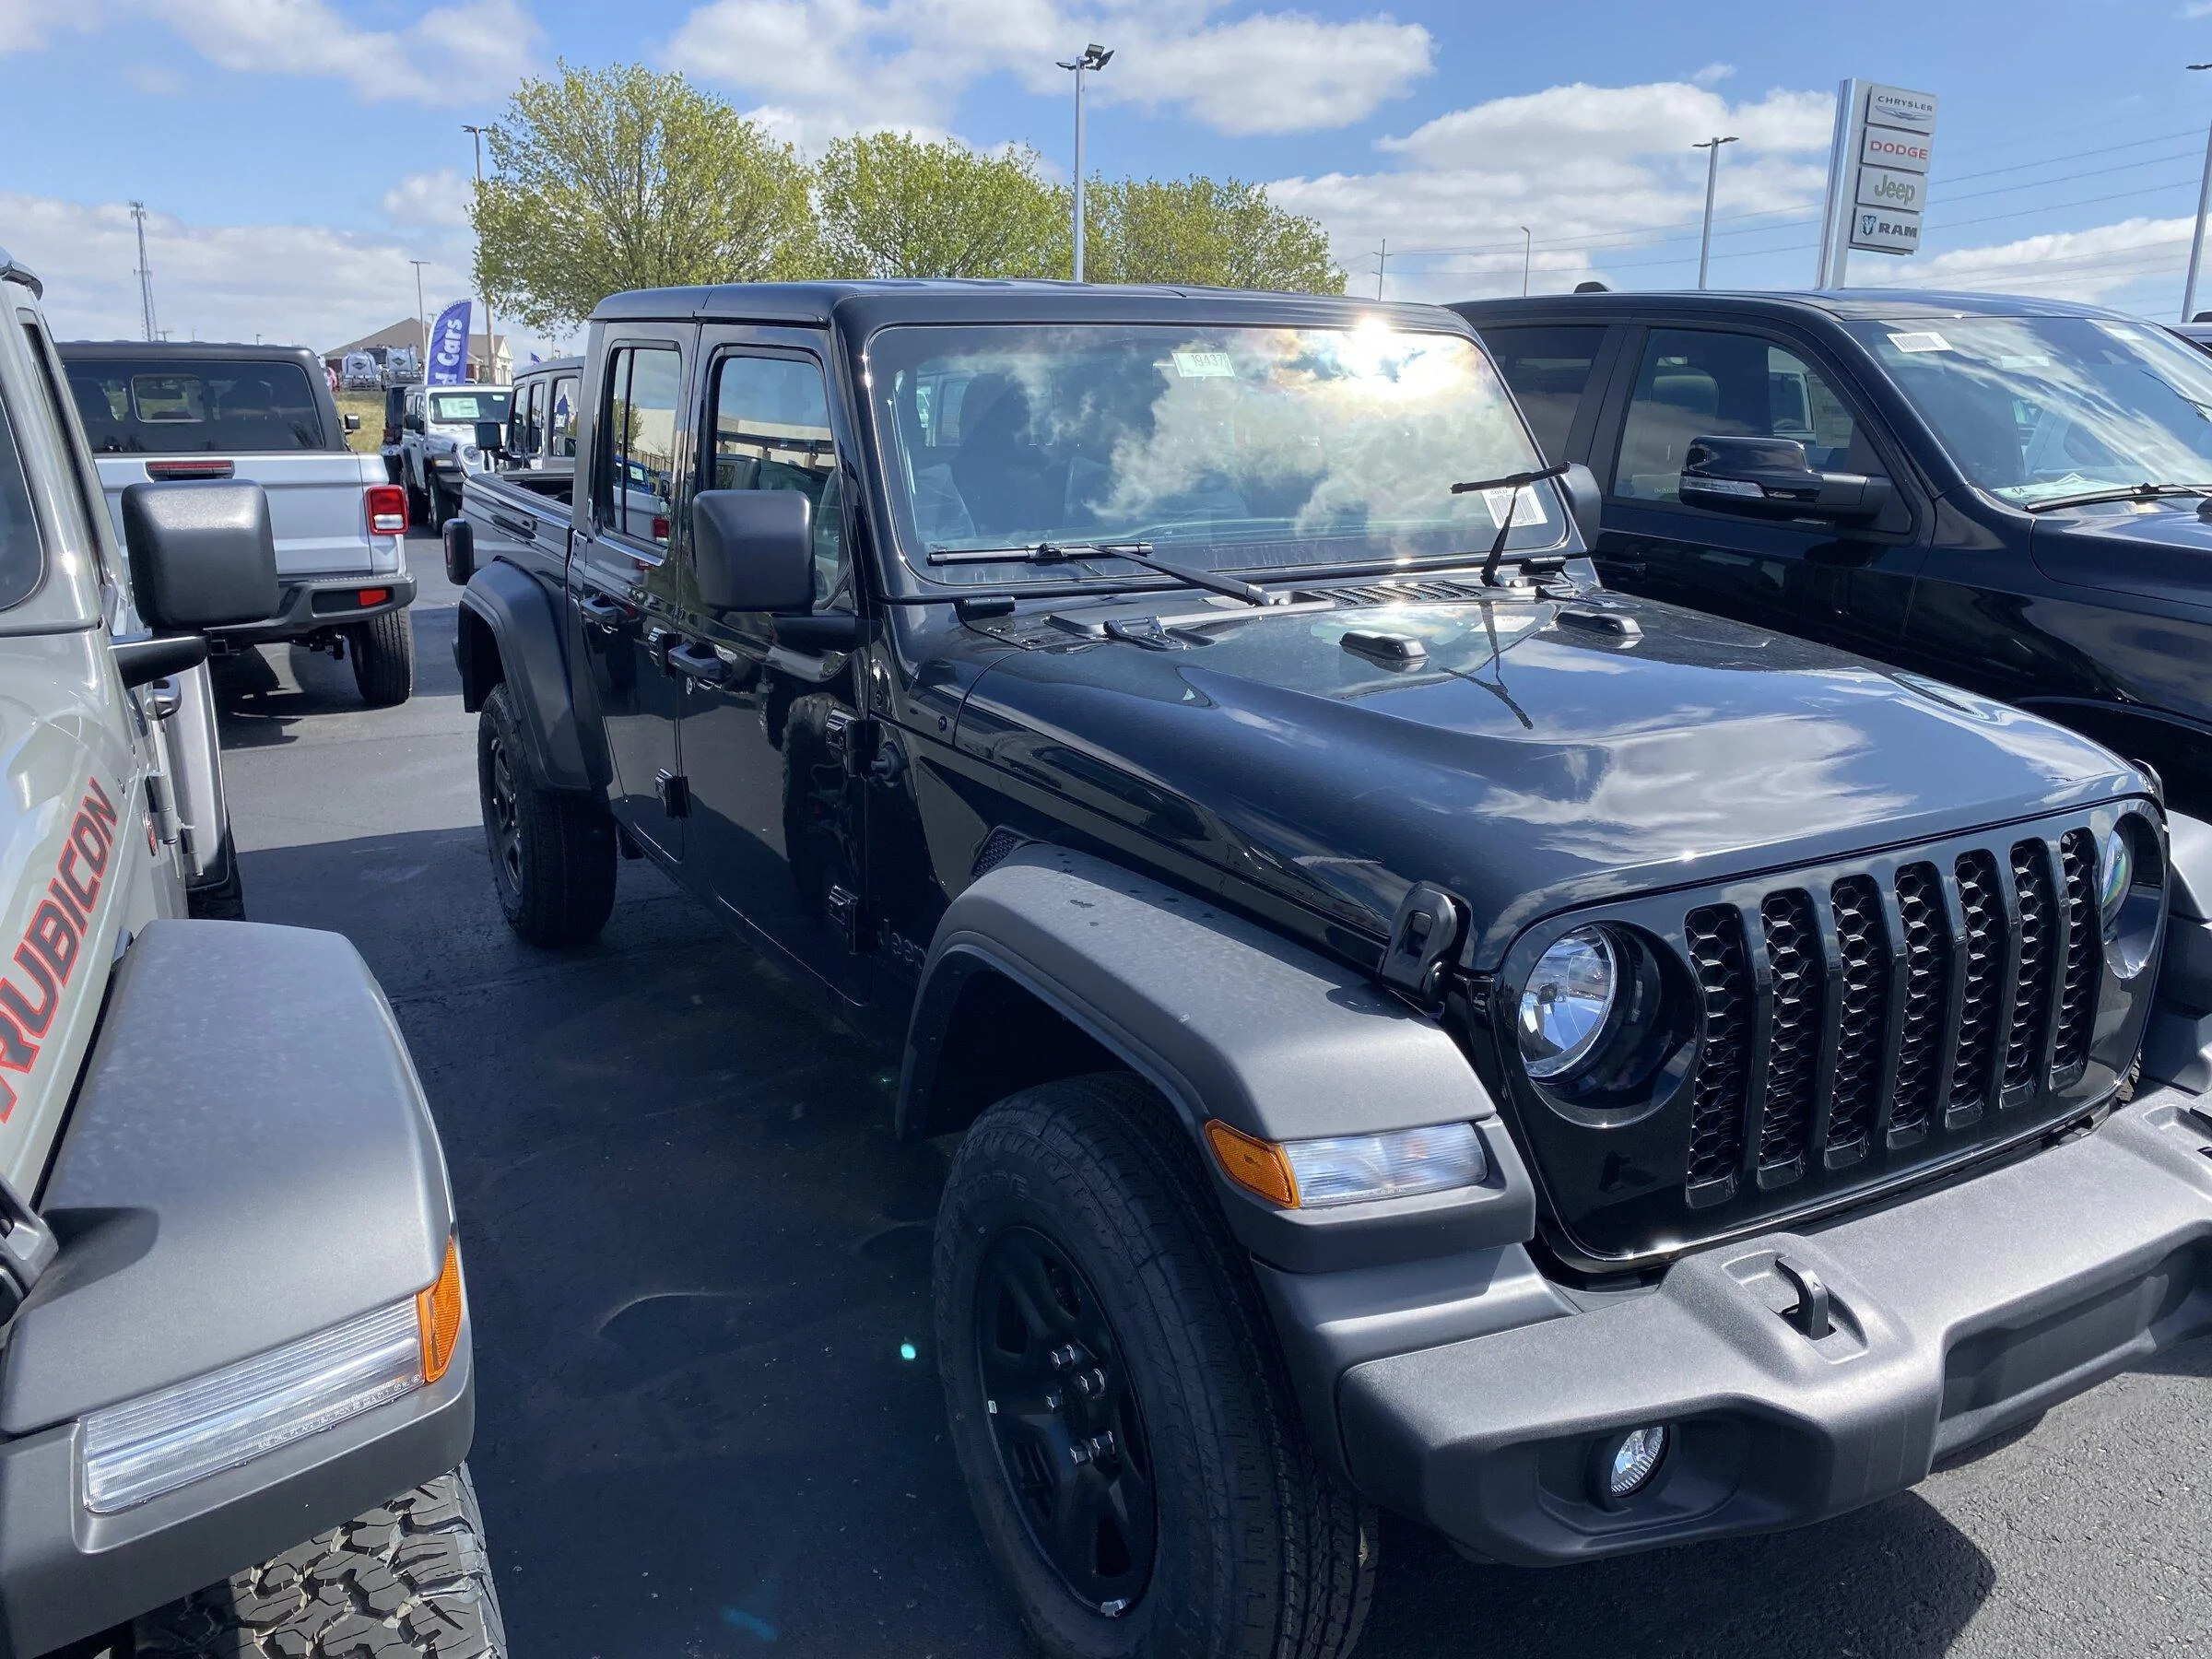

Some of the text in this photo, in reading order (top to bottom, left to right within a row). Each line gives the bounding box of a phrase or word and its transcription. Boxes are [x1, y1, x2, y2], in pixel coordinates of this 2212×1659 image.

[1877, 95, 1933, 112] CHRYSLER
[1870, 141, 1928, 160] DODGE
[1874, 174, 1916, 206] Jeep
[1878, 222, 1918, 239] RAM
[437, 319, 463, 367] Cars
